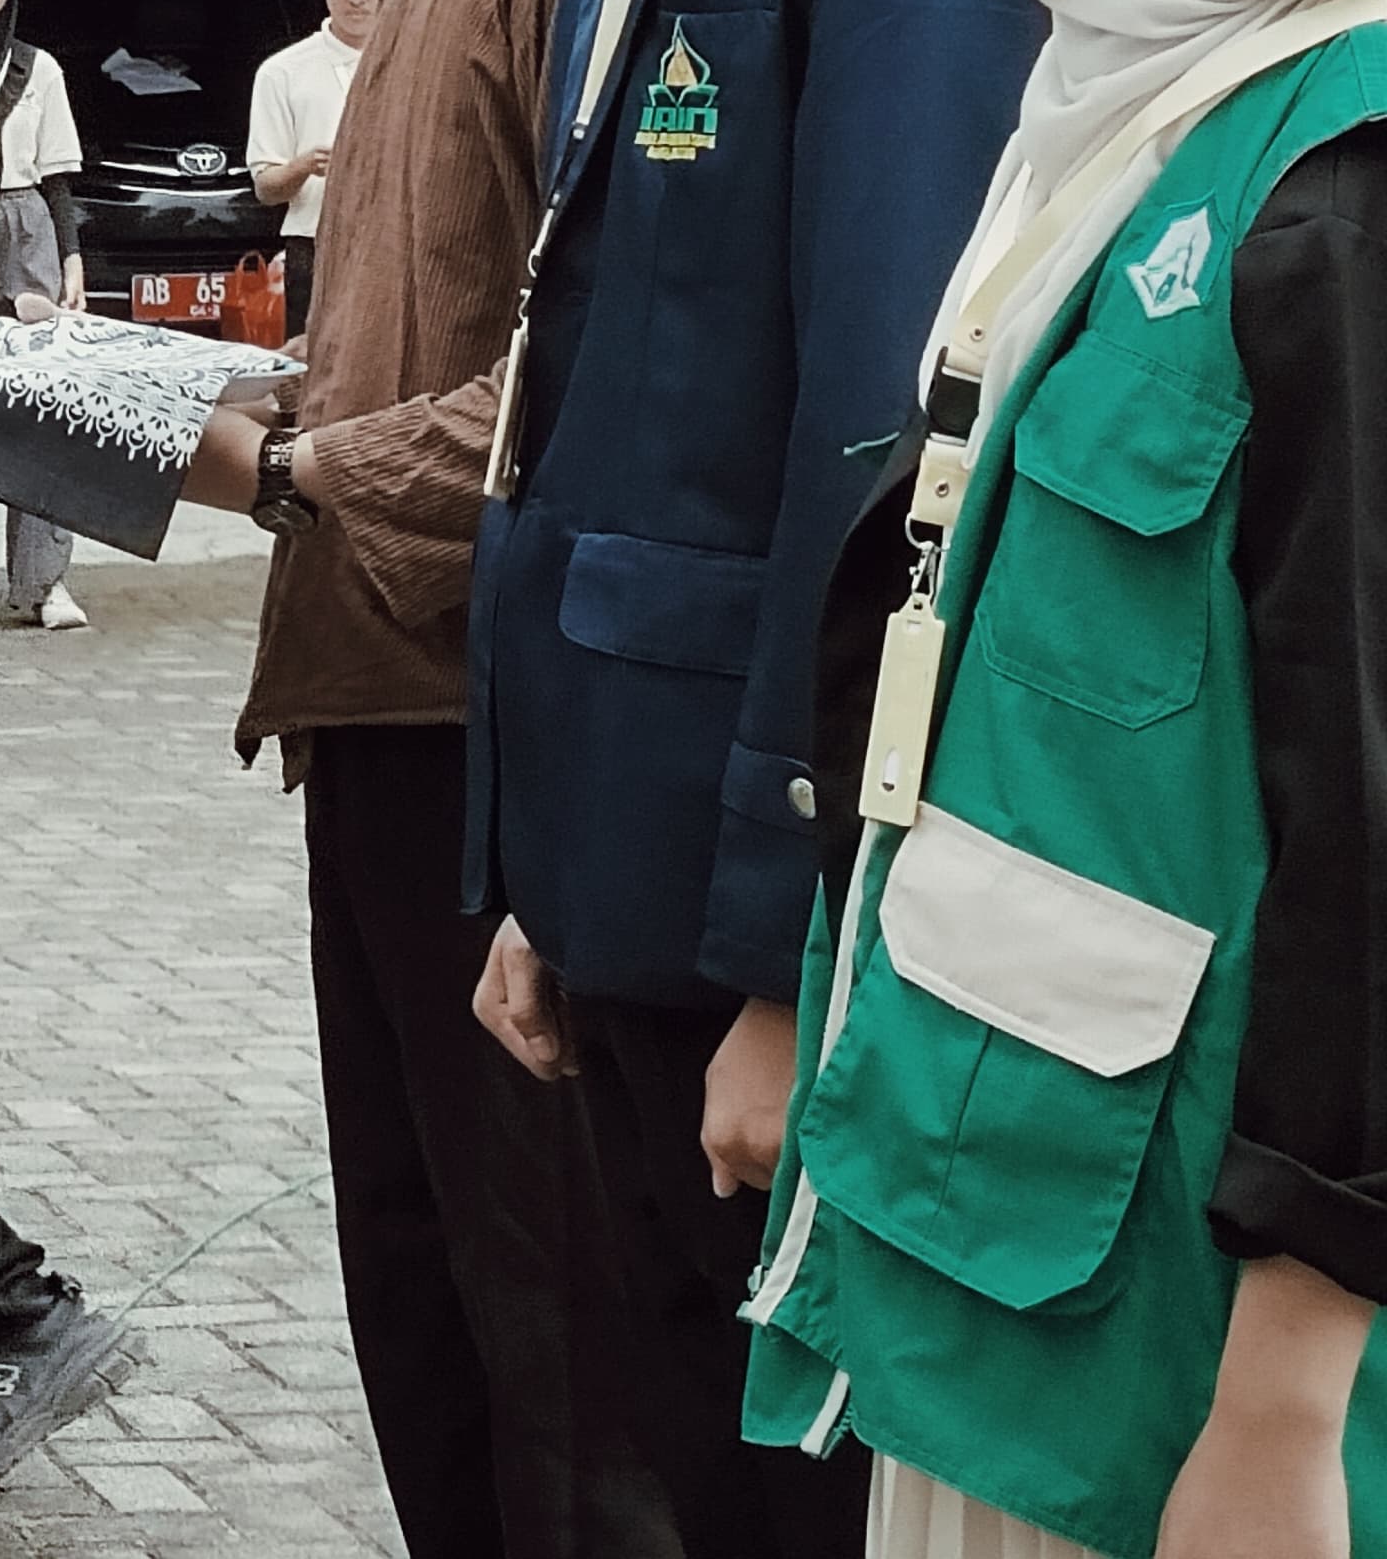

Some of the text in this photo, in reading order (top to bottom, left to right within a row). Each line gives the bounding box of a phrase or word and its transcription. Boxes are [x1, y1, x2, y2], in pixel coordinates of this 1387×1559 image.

[639, 106, 718, 133] IAIN
[141, 276, 226, 305] AB 65
